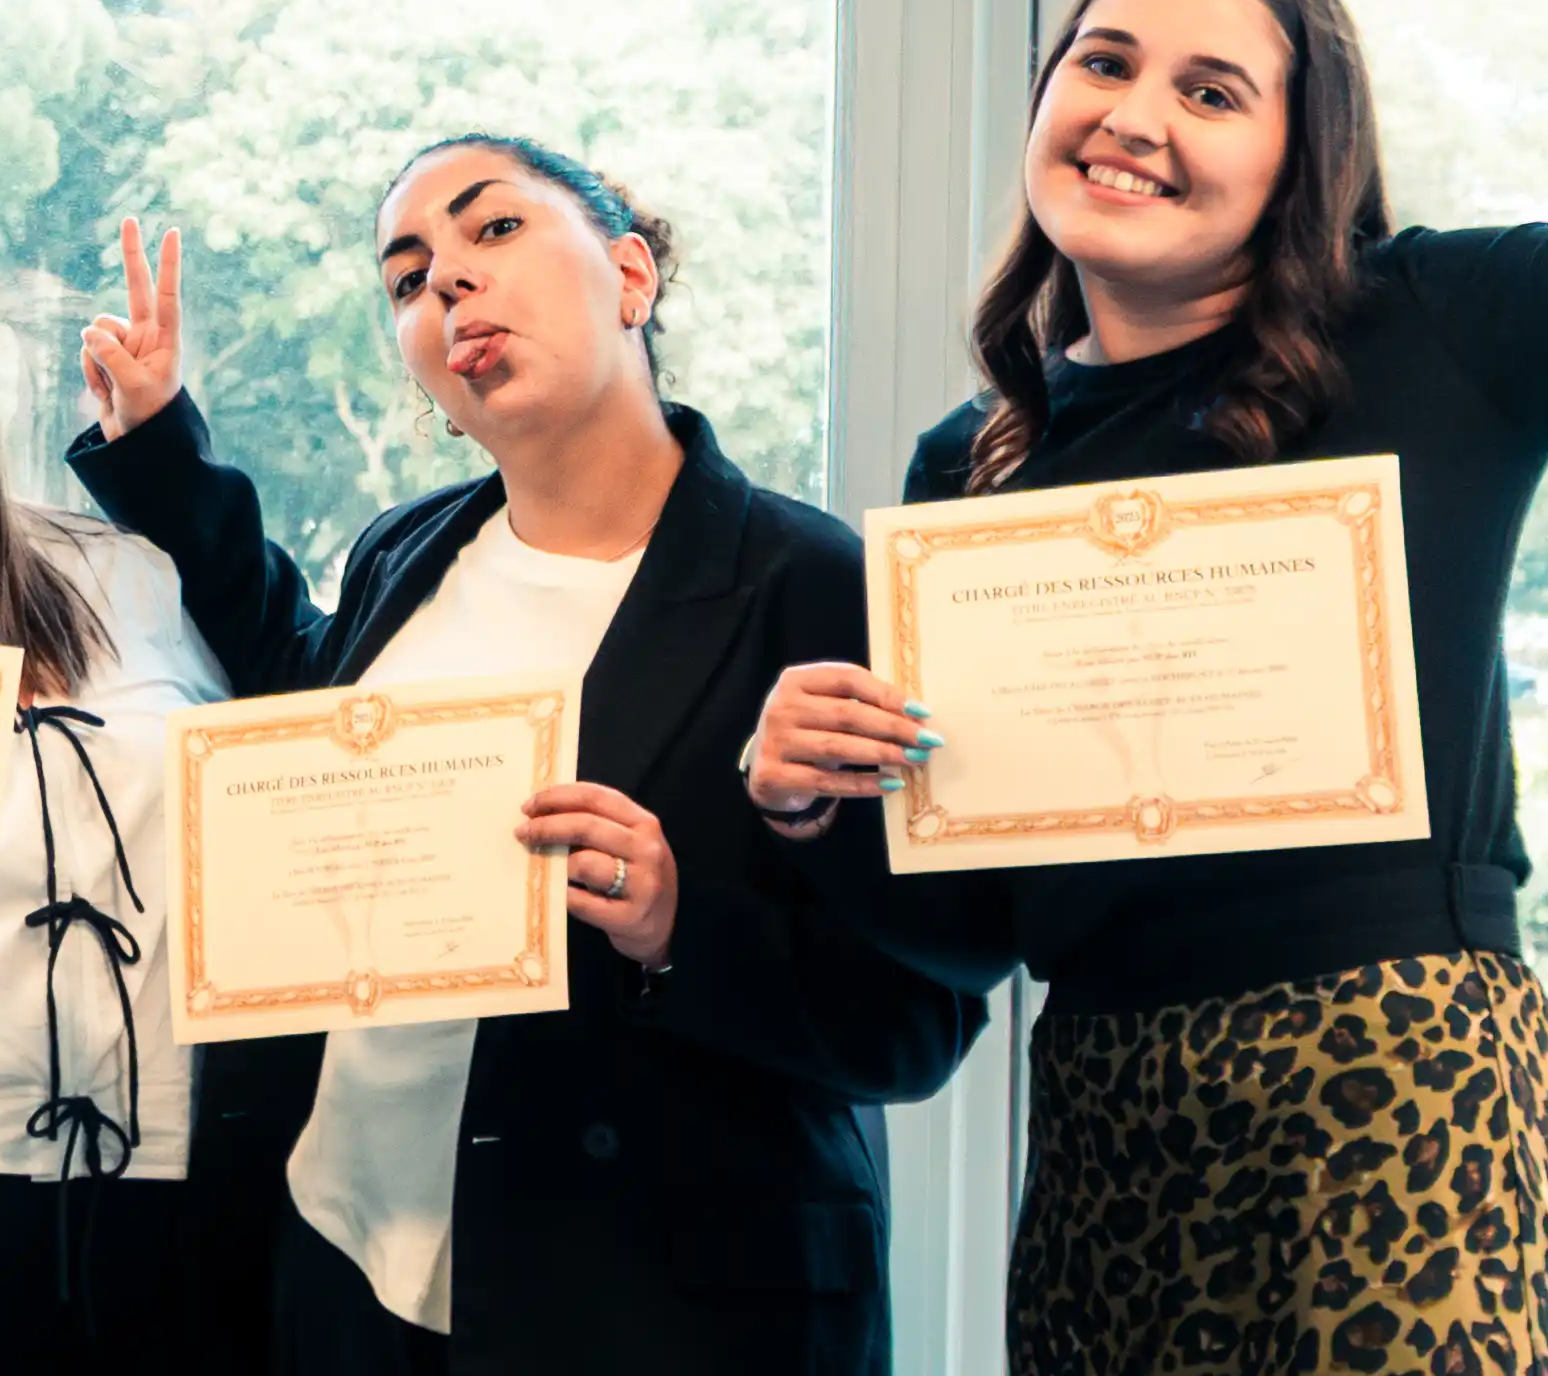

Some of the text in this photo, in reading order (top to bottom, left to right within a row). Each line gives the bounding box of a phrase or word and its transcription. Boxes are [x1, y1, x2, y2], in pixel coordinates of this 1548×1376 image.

[1035, 579, 1073, 597] DES
[1078, 568, 1205, 592] RESSOURCES
[1210, 556, 1316, 580] HUMAINES
[289, 773, 318, 790] DES
[321, 763, 418, 786] RESSOURCES
[421, 753, 505, 774] HUMAINES
